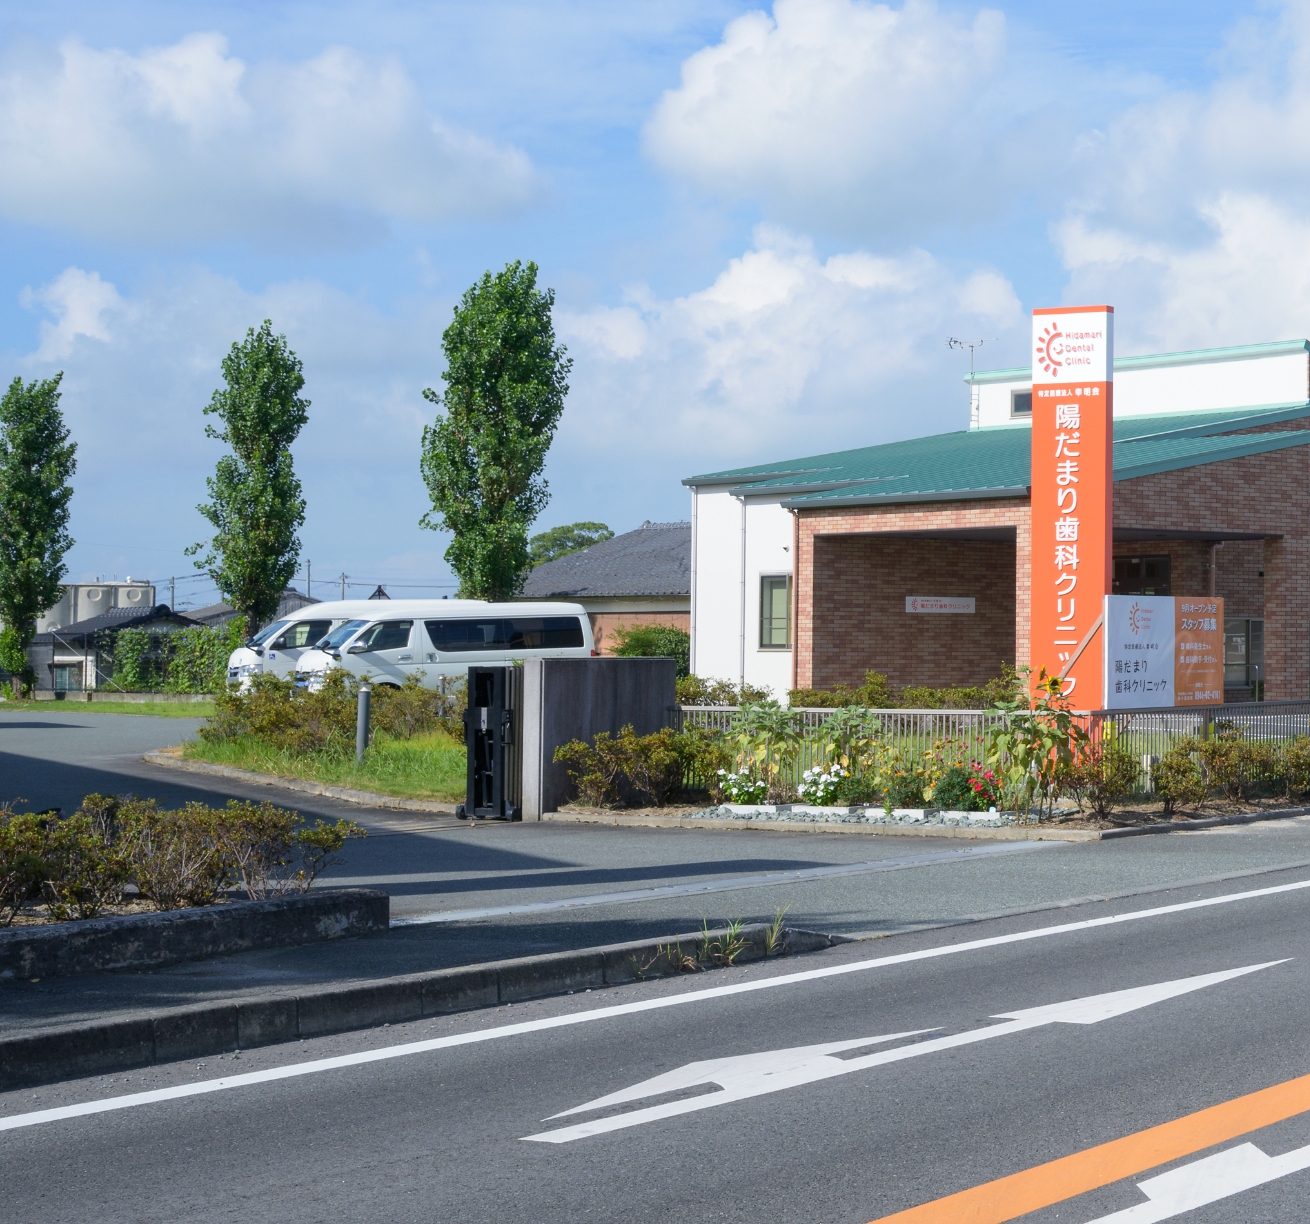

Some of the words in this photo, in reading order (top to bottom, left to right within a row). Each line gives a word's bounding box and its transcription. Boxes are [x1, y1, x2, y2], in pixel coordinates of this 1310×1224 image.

[1065, 330, 1102, 340] Hidamari
[1065, 343, 1094, 353] Dental
[1065, 357, 1091, 366] Clinic
[1181, 604, 1217, 614] 9月オープン予定
[1181, 618, 1217, 631] スタッフ募集
[1115, 660, 1148, 674] 陽だまり
[1115, 679, 1167, 694] 歯科クリニック
